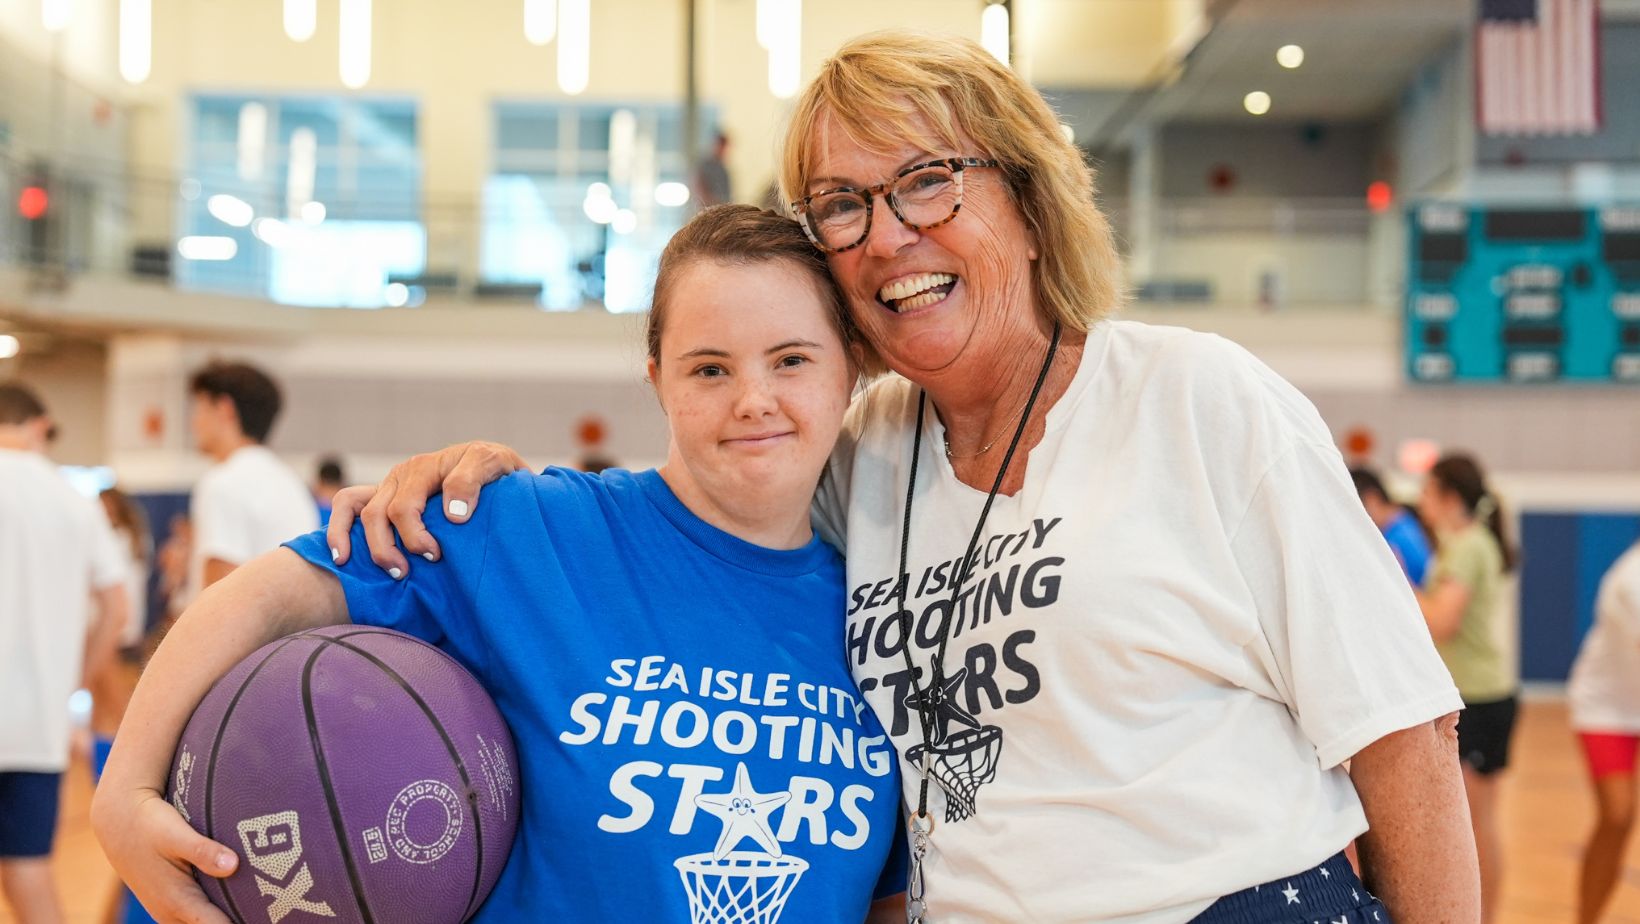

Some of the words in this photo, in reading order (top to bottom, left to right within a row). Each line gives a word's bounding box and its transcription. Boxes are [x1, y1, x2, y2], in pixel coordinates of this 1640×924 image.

[848, 573, 910, 616] SEA
[984, 517, 1063, 569] CITY
[847, 556, 1066, 670] HOOTING
[605, 655, 689, 694] SEA
[699, 667, 791, 706] ISLE
[797, 682, 865, 726] CITY
[559, 692, 891, 777] SHOOTING
[395, 838, 420, 858] AND
[423, 819, 460, 859] SCHOOL
[597, 761, 875, 851] STRS
